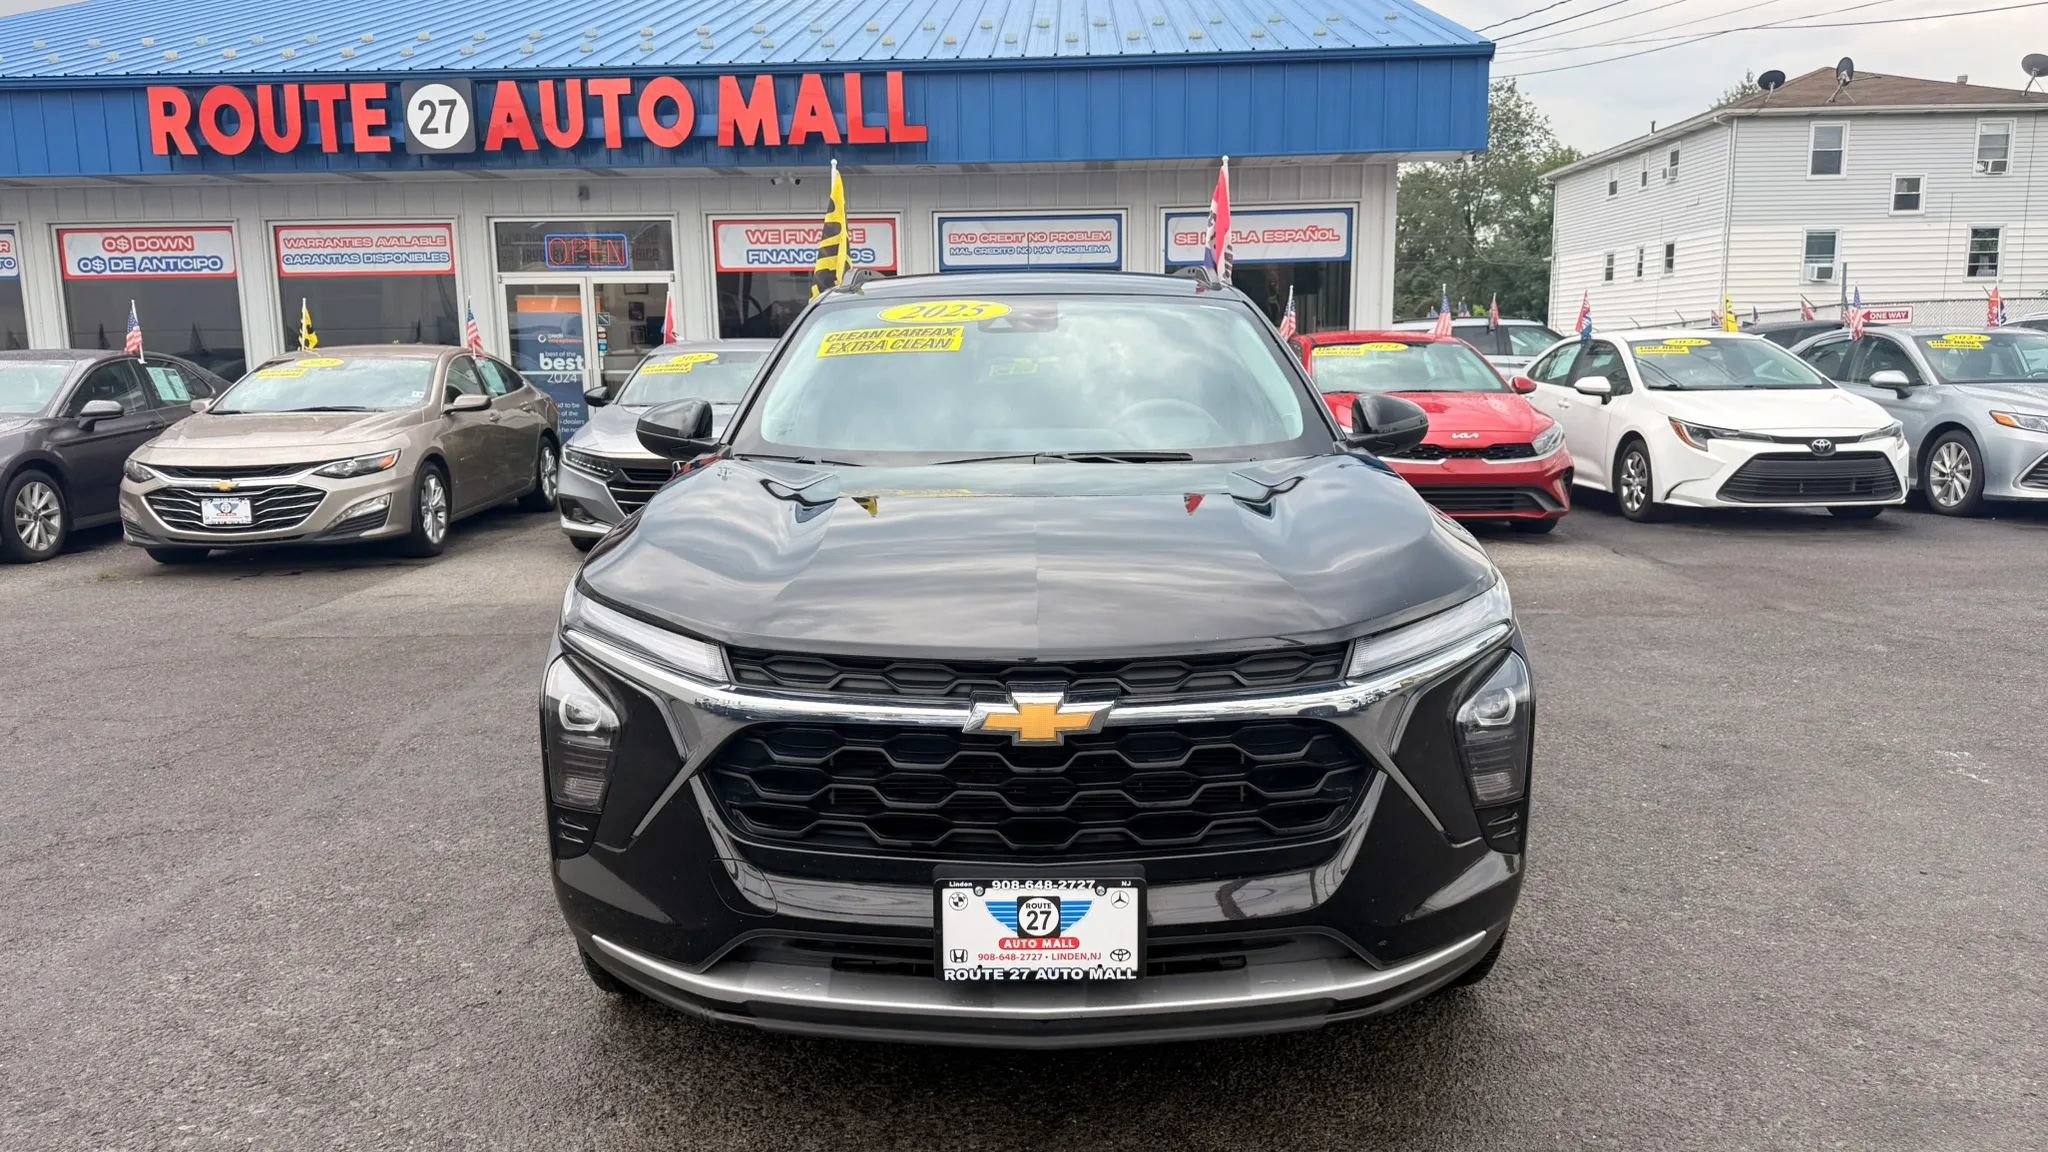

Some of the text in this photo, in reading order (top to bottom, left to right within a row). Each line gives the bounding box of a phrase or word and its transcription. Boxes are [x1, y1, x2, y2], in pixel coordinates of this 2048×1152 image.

[147, 71, 928, 155] ROUTE 27 AUTO MALL
[746, 229, 780, 245] WE
[949, 231, 1111, 244] BAD CREDIT NO PROBLEM
[1175, 232, 1198, 245] SE
[1263, 225, 1340, 243] ESPAÑOL
[133, 236, 193, 251] DOWN
[283, 236, 446, 249] WARRANTIES AVAILABLE
[549, 237, 625, 266] OPEN
[950, 245, 1111, 256] MAL CREDITO NO HAY PROBLEMA
[109, 257, 136, 272] DE
[138, 256, 223, 272] ANTICIPO
[282, 251, 449, 265] GARANTIAS DISPONIBLES
[900, 304, 988, 320] 2025
[1869, 311, 1907, 320] ONE WAY
[825, 327, 957, 343] CLEAN CARFAX
[825, 337, 952, 354] EXTRA CLEAN
[539, 353, 584, 370] best
[547, 373, 577, 383] 2024
[992, 880, 1096, 890] 908-648-2727
[1025, 902, 1051, 910] ROUTE
[1026, 910, 1051, 931] 27
[1003, 938, 1075, 949] AUTO MALL
[977, 953, 1043, 961] 908-648-2727
[944, 968, 1137, 981] ROUTE 27 AUTO MALL
